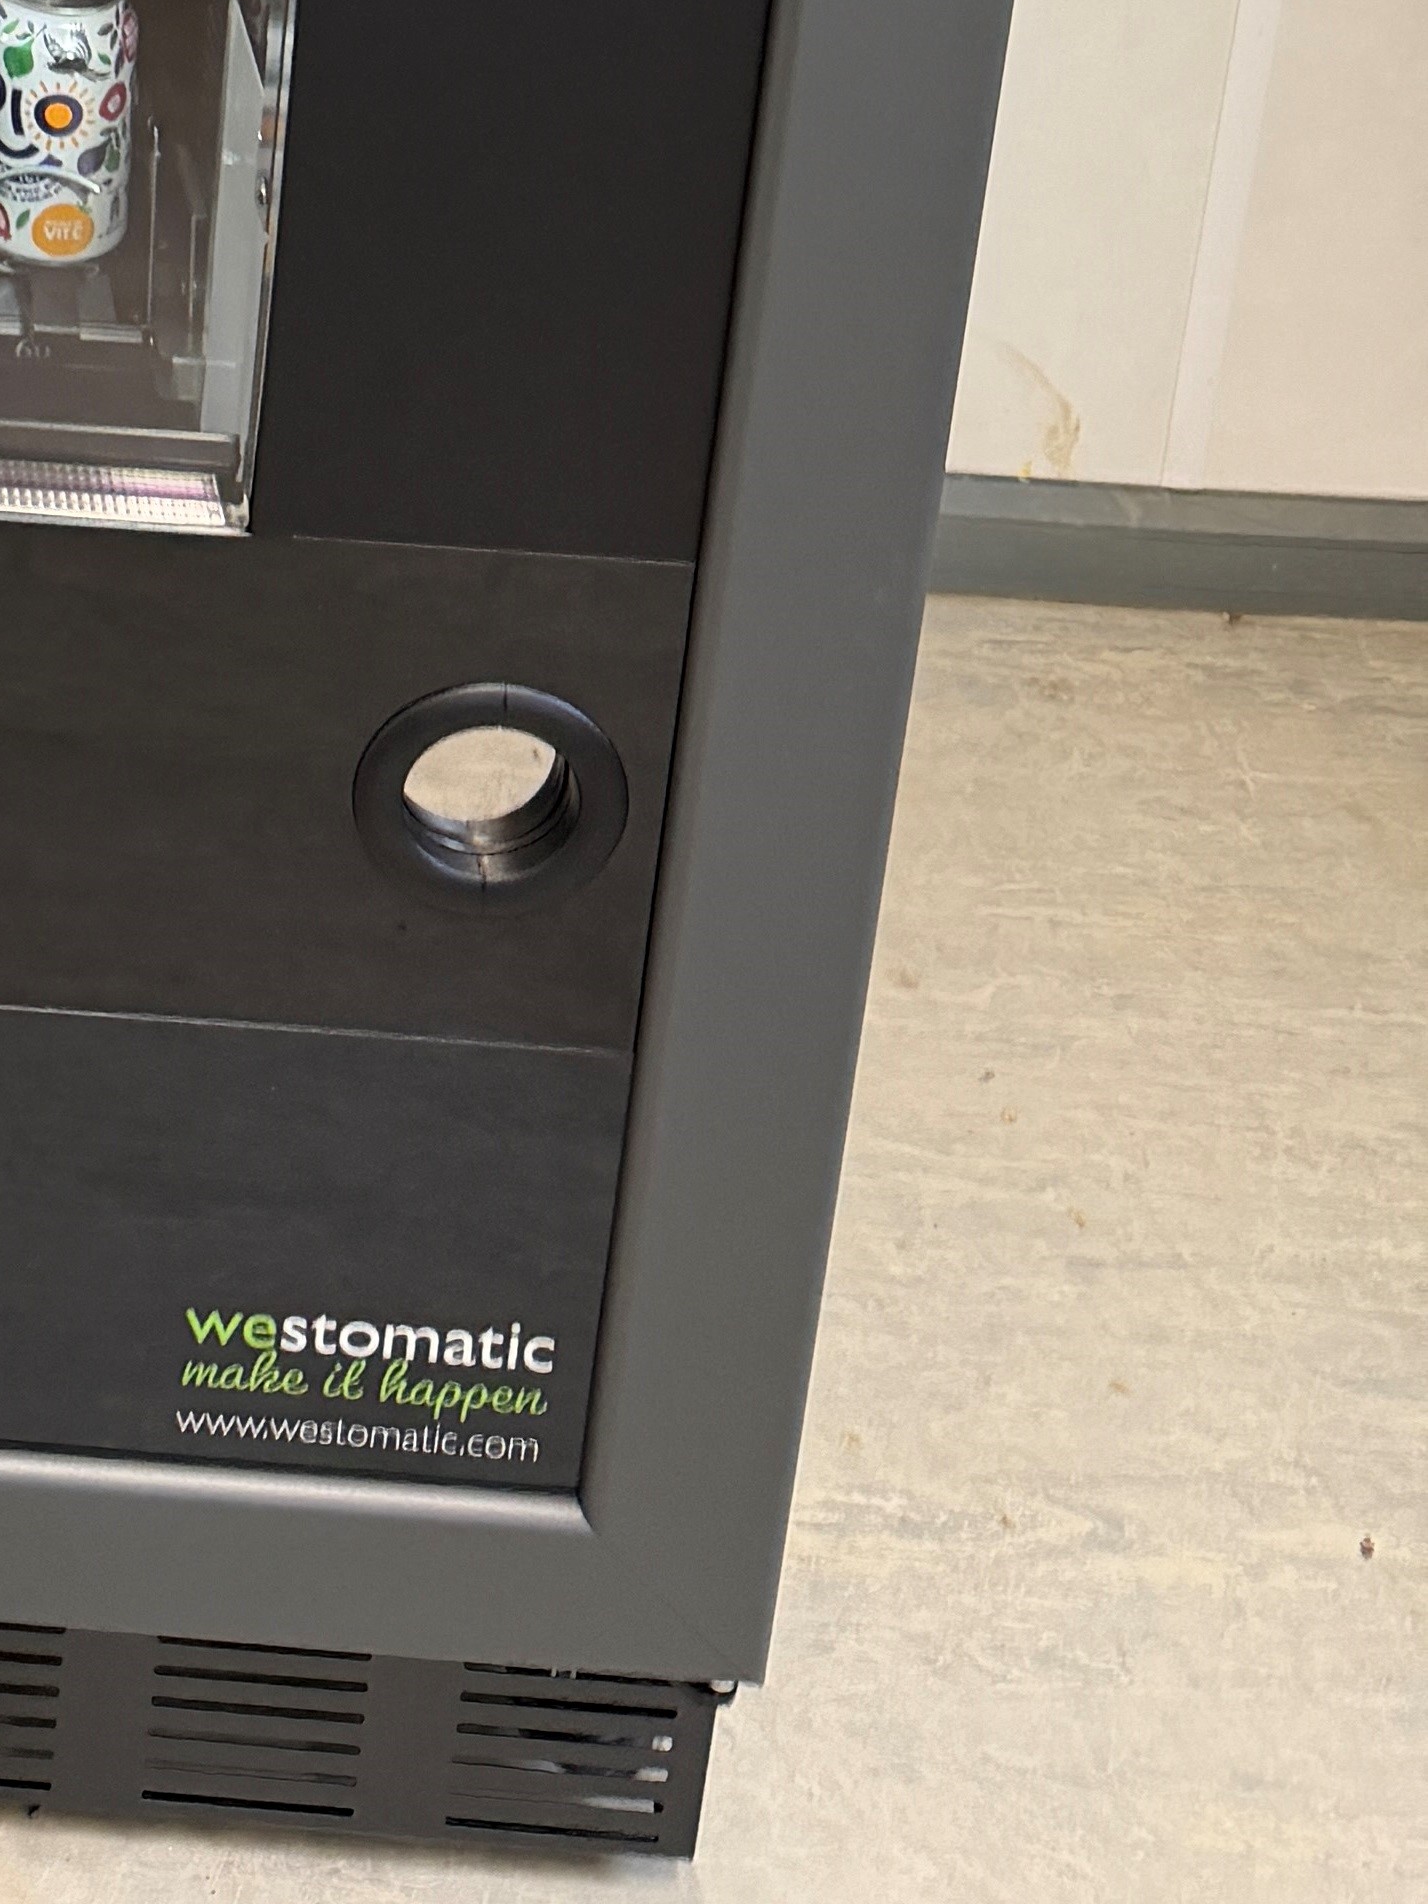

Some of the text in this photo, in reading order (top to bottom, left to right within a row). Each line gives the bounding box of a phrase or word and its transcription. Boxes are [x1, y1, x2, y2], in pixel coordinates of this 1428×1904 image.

[184, 1306, 557, 1376] westomatic
[180, 1350, 549, 1425] make it happen
[175, 1408, 540, 1464] www.westomatic.com
